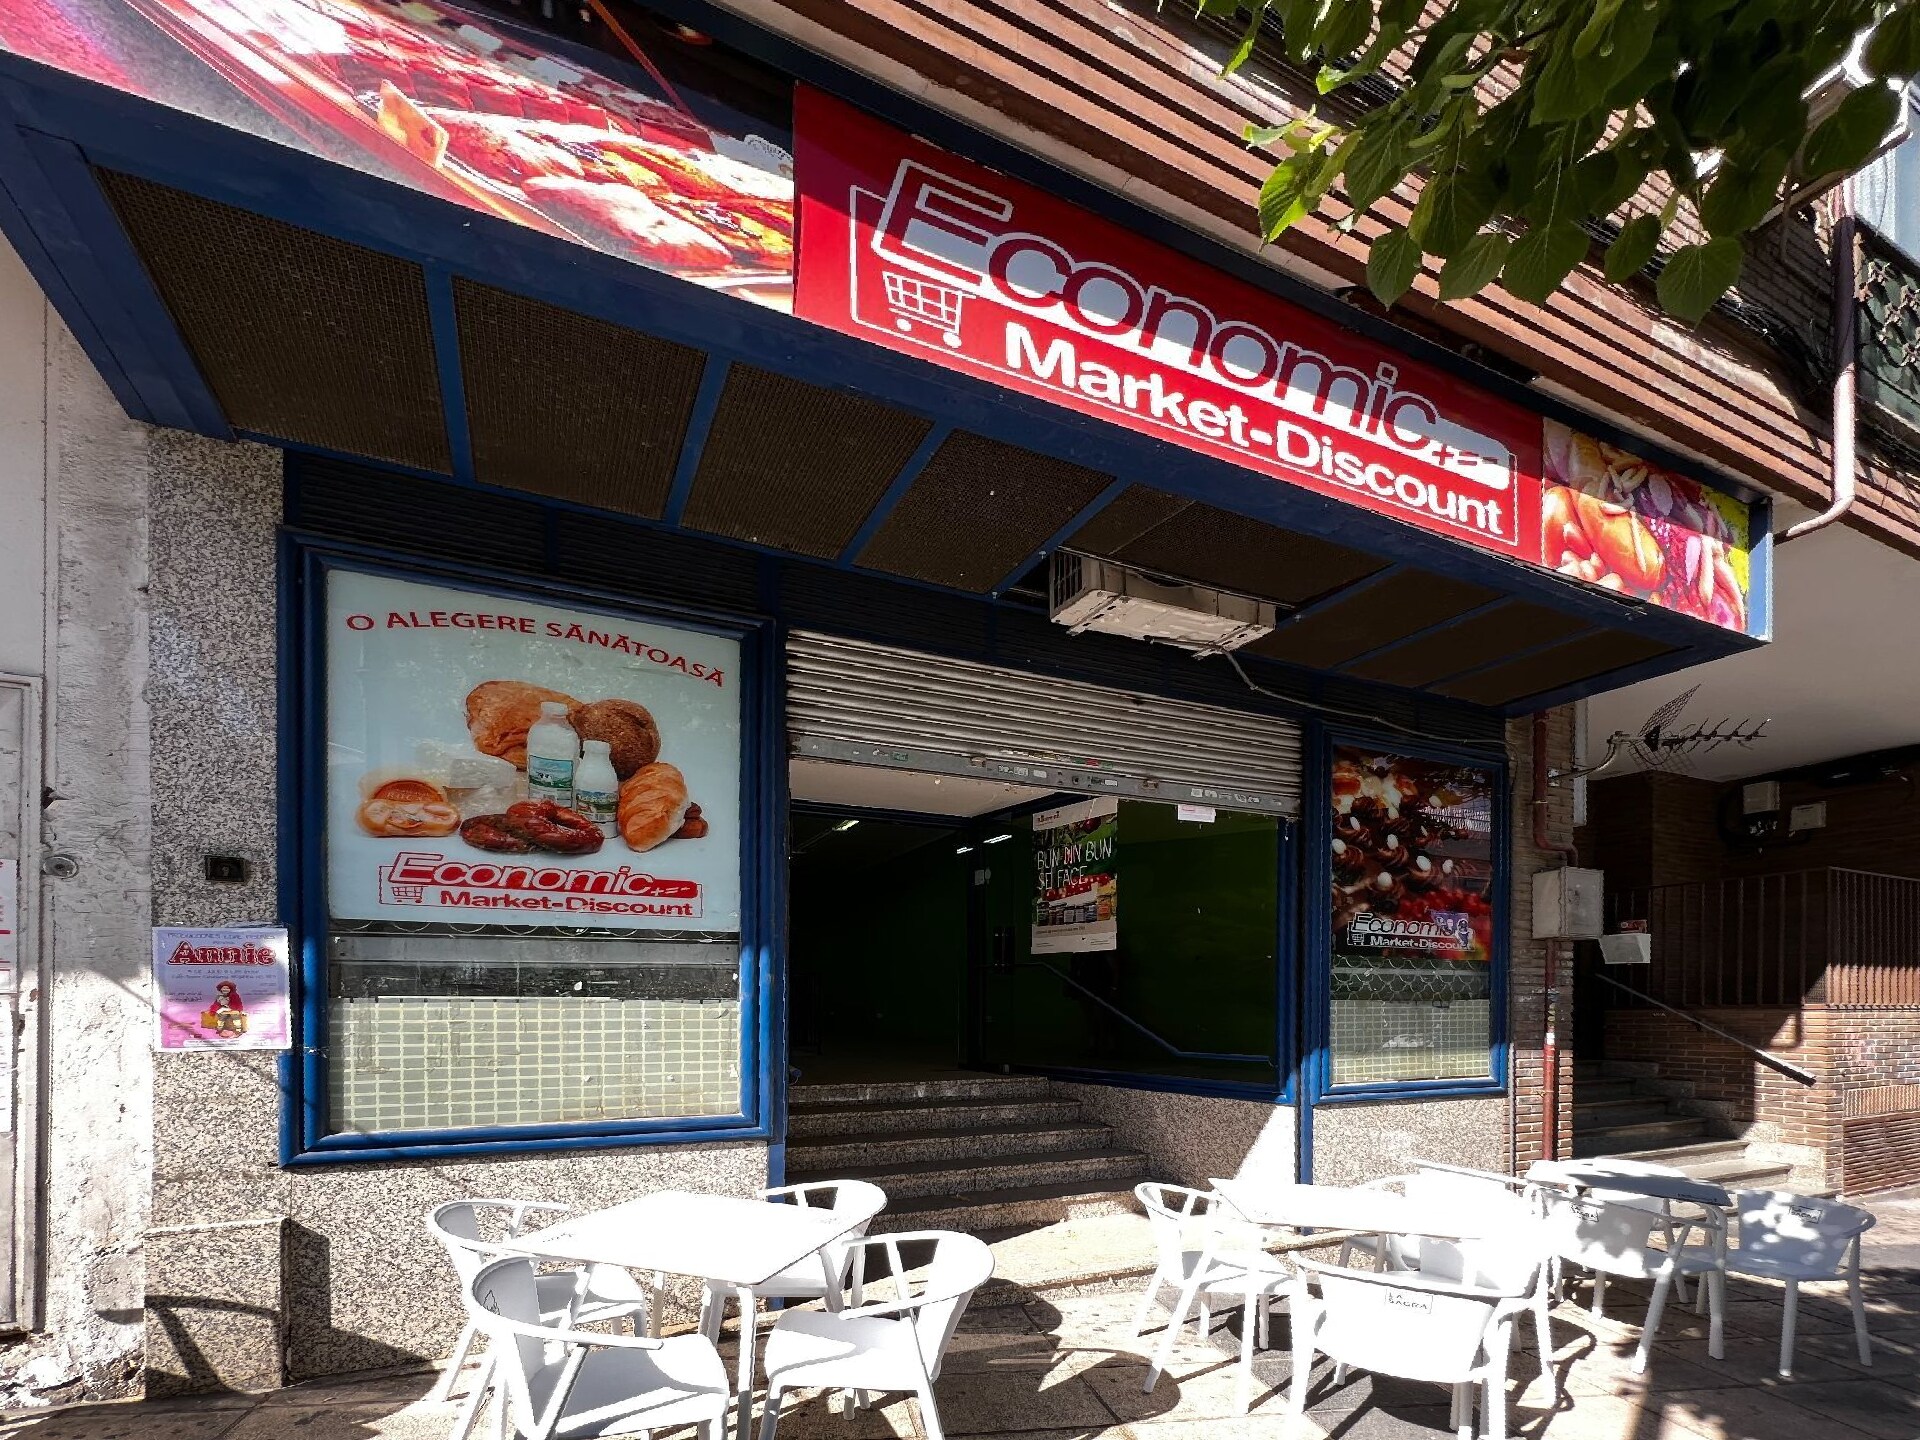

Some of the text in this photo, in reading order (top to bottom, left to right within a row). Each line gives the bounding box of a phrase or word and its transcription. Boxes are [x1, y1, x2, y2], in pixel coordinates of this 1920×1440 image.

[871, 158, 1442, 453] Economic
[1005, 321, 1503, 536] Market-Discount
[346, 611, 725, 688] O ALEGERE SĂNĂTOASĂ
[1037, 848, 1059, 871] BUN
[1085, 837, 1112, 862] BUN
[388, 852, 655, 896] Economic
[1057, 865, 1088, 888] FACE
[440, 889, 693, 917] Market-Discount
[167, 941, 277, 966] Annie
[1370, 935, 1469, 949] Market-Discou
